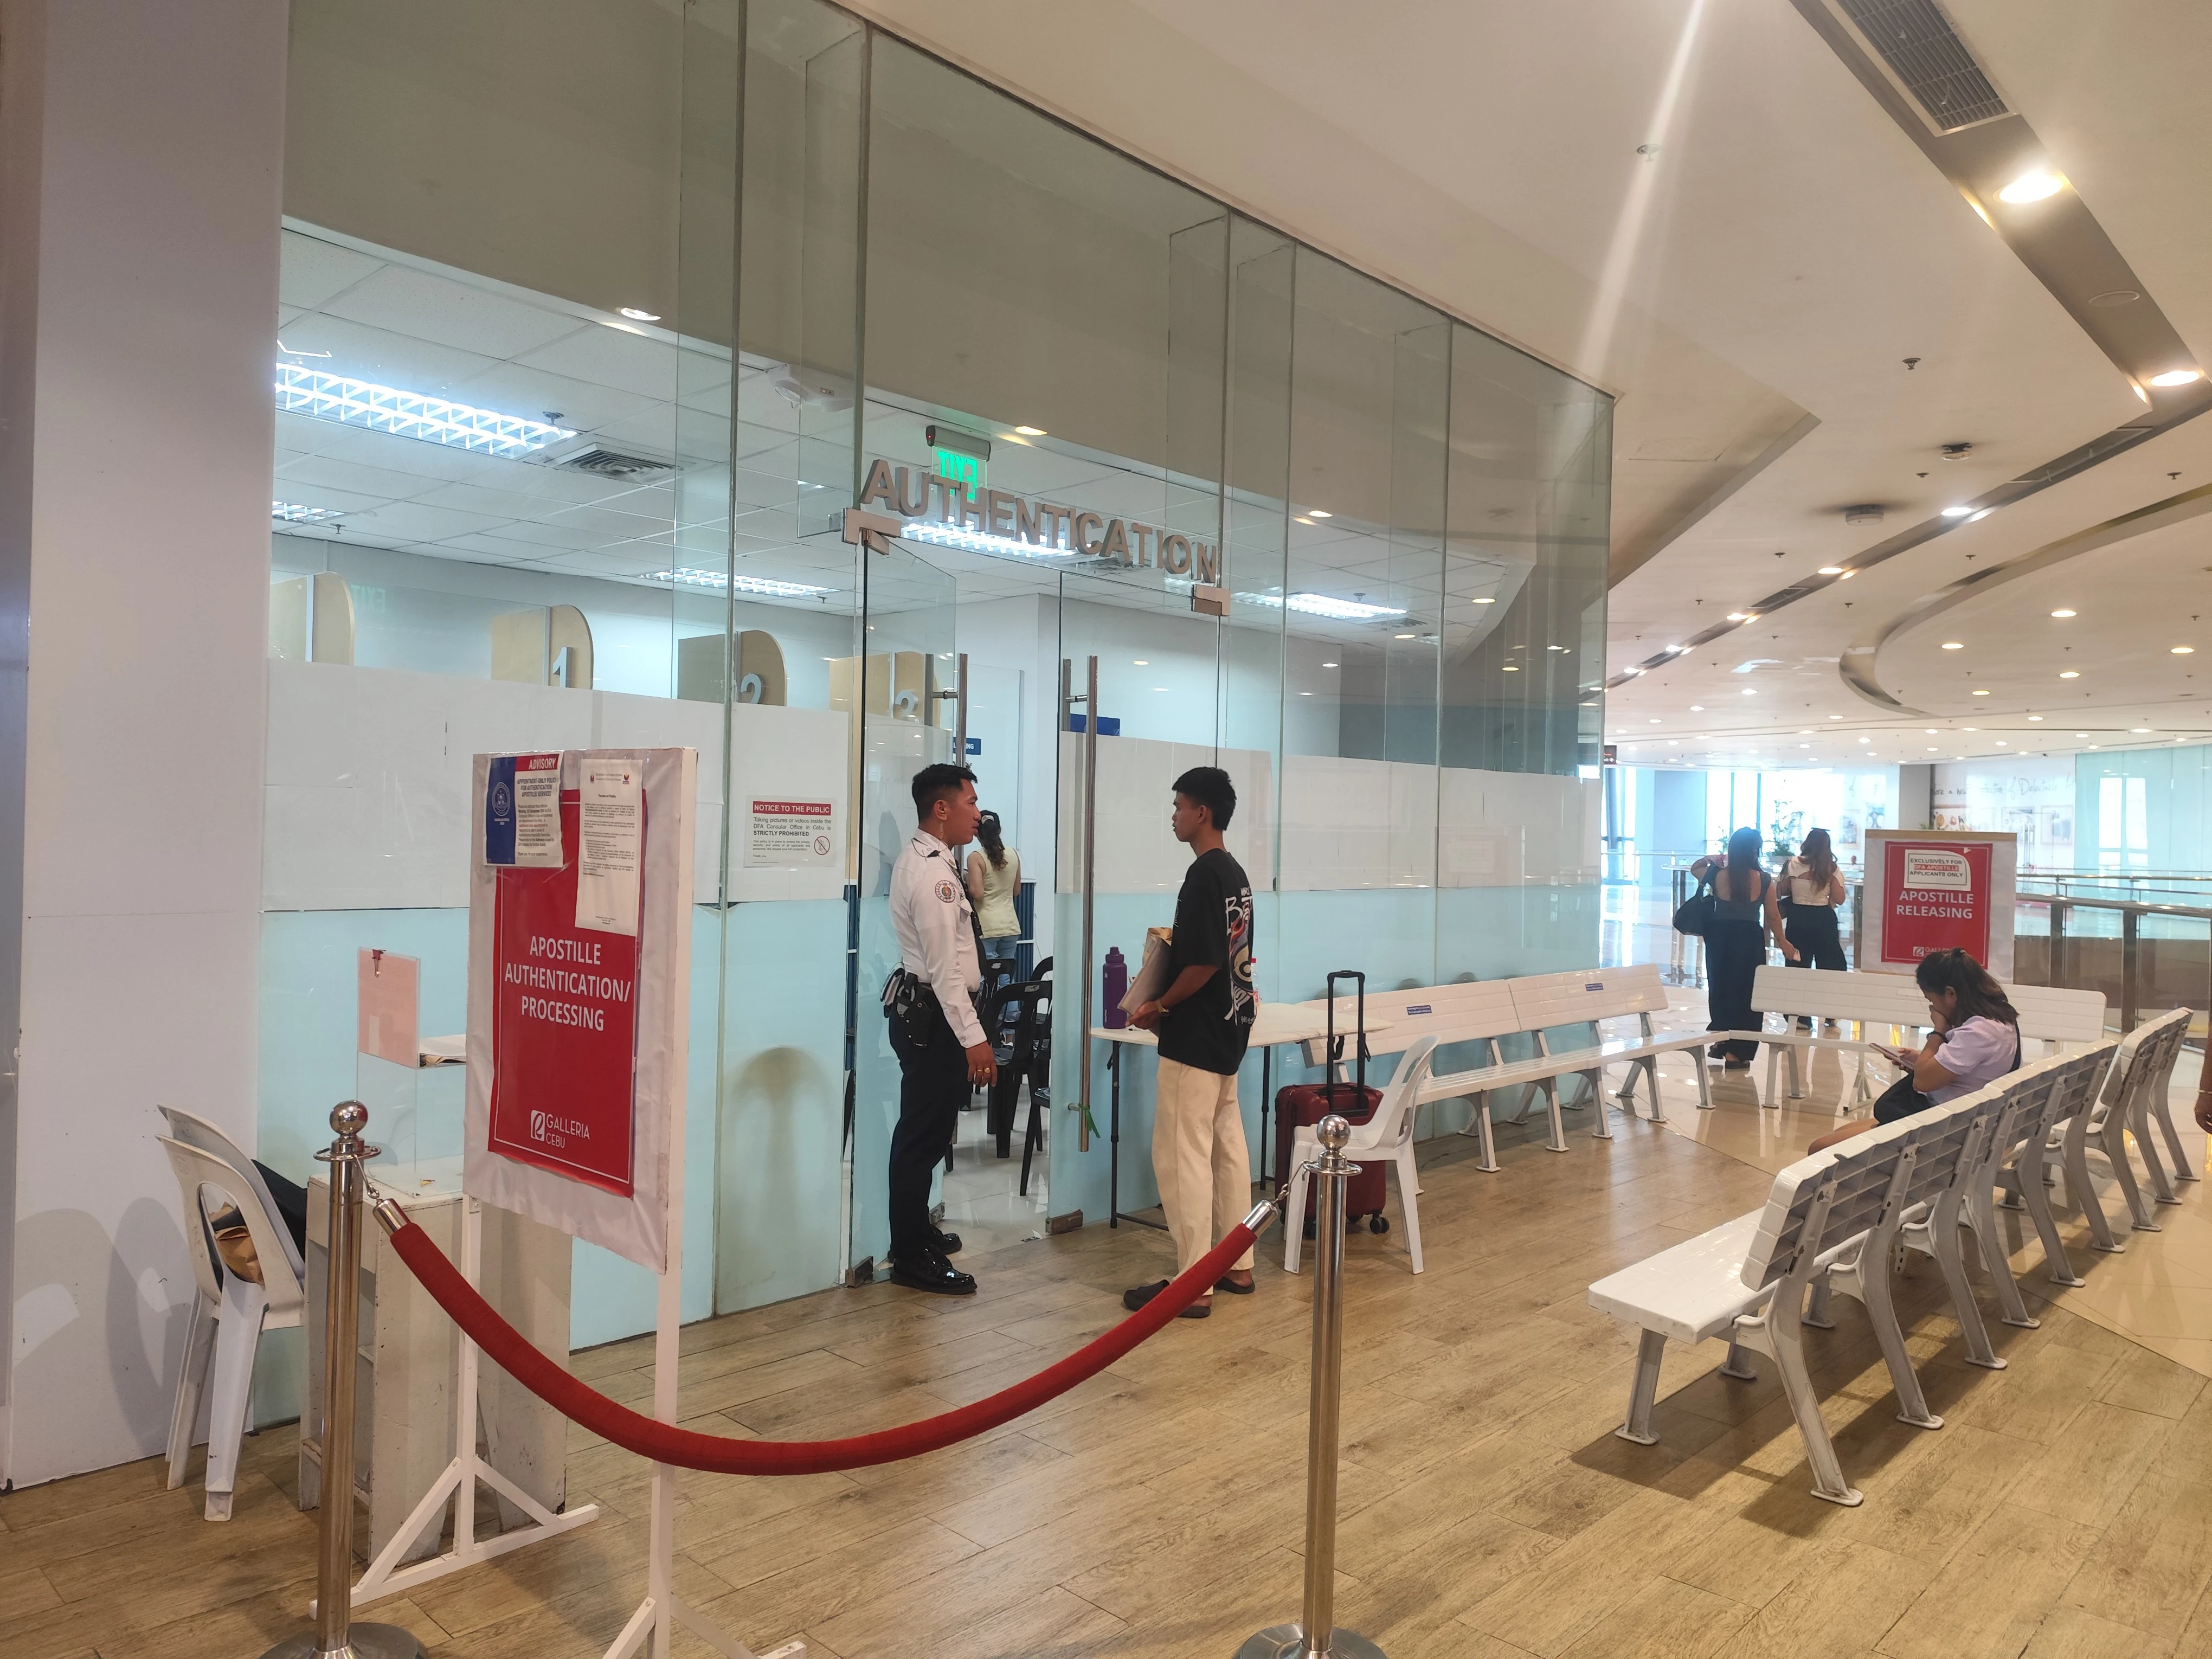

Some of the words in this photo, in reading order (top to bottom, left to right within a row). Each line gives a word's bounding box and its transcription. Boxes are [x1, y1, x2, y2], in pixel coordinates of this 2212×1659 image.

[859, 459, 1217, 583] AUTHENTICATION
[552, 647, 569, 687] 1
[529, 758, 556, 770] ADVISORY
[1899, 890, 1973, 904] APOSTILLE
[1896, 905, 1972, 918] RELEASING
[530, 936, 601, 965] APOSTILLE
[505, 963, 631, 1002] AUTHENTICATION/
[522, 995, 604, 1031] PROCESSING
[545, 1133, 565, 1148] CEBU
[546, 1114, 590, 1140] GALLERIA
